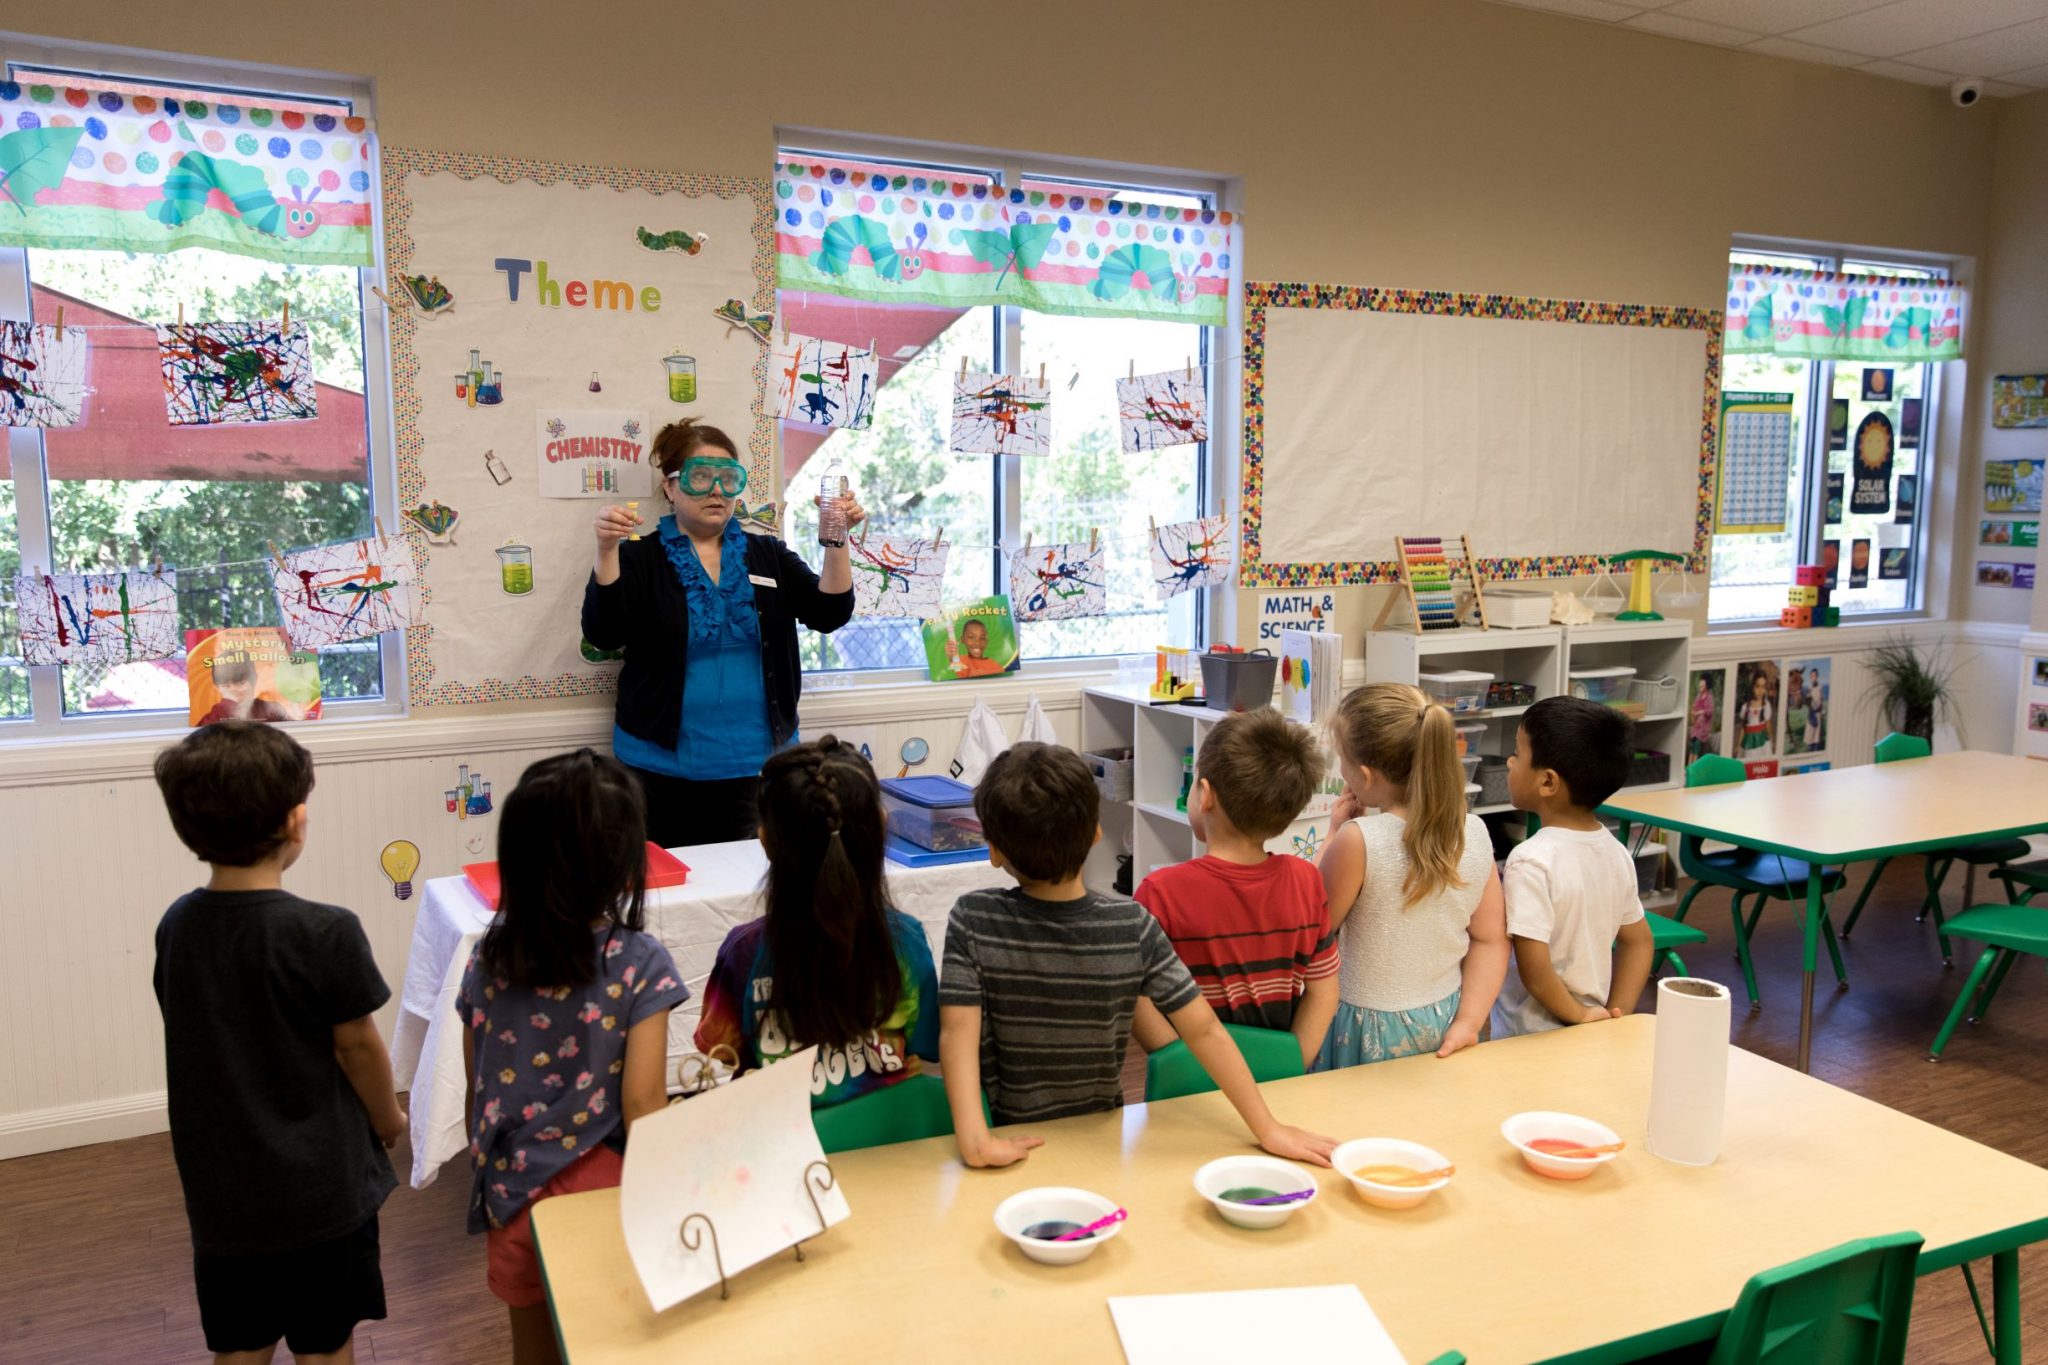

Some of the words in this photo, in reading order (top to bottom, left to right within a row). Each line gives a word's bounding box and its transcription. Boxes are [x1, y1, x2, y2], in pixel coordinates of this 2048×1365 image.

[495, 258, 662, 312] Theme
[545, 436, 643, 464] CHEMISTRY
[1858, 478, 1885, 491] SOLAR
[1854, 491, 1886, 504] SYSTEM
[962, 605, 1007, 617] Rocket
[1265, 596, 1312, 614] MATH
[1322, 595, 1333, 611] &
[221, 638, 288, 651] Mystery
[203, 651, 244, 668] Smell
[249, 651, 306, 666] Balloon
